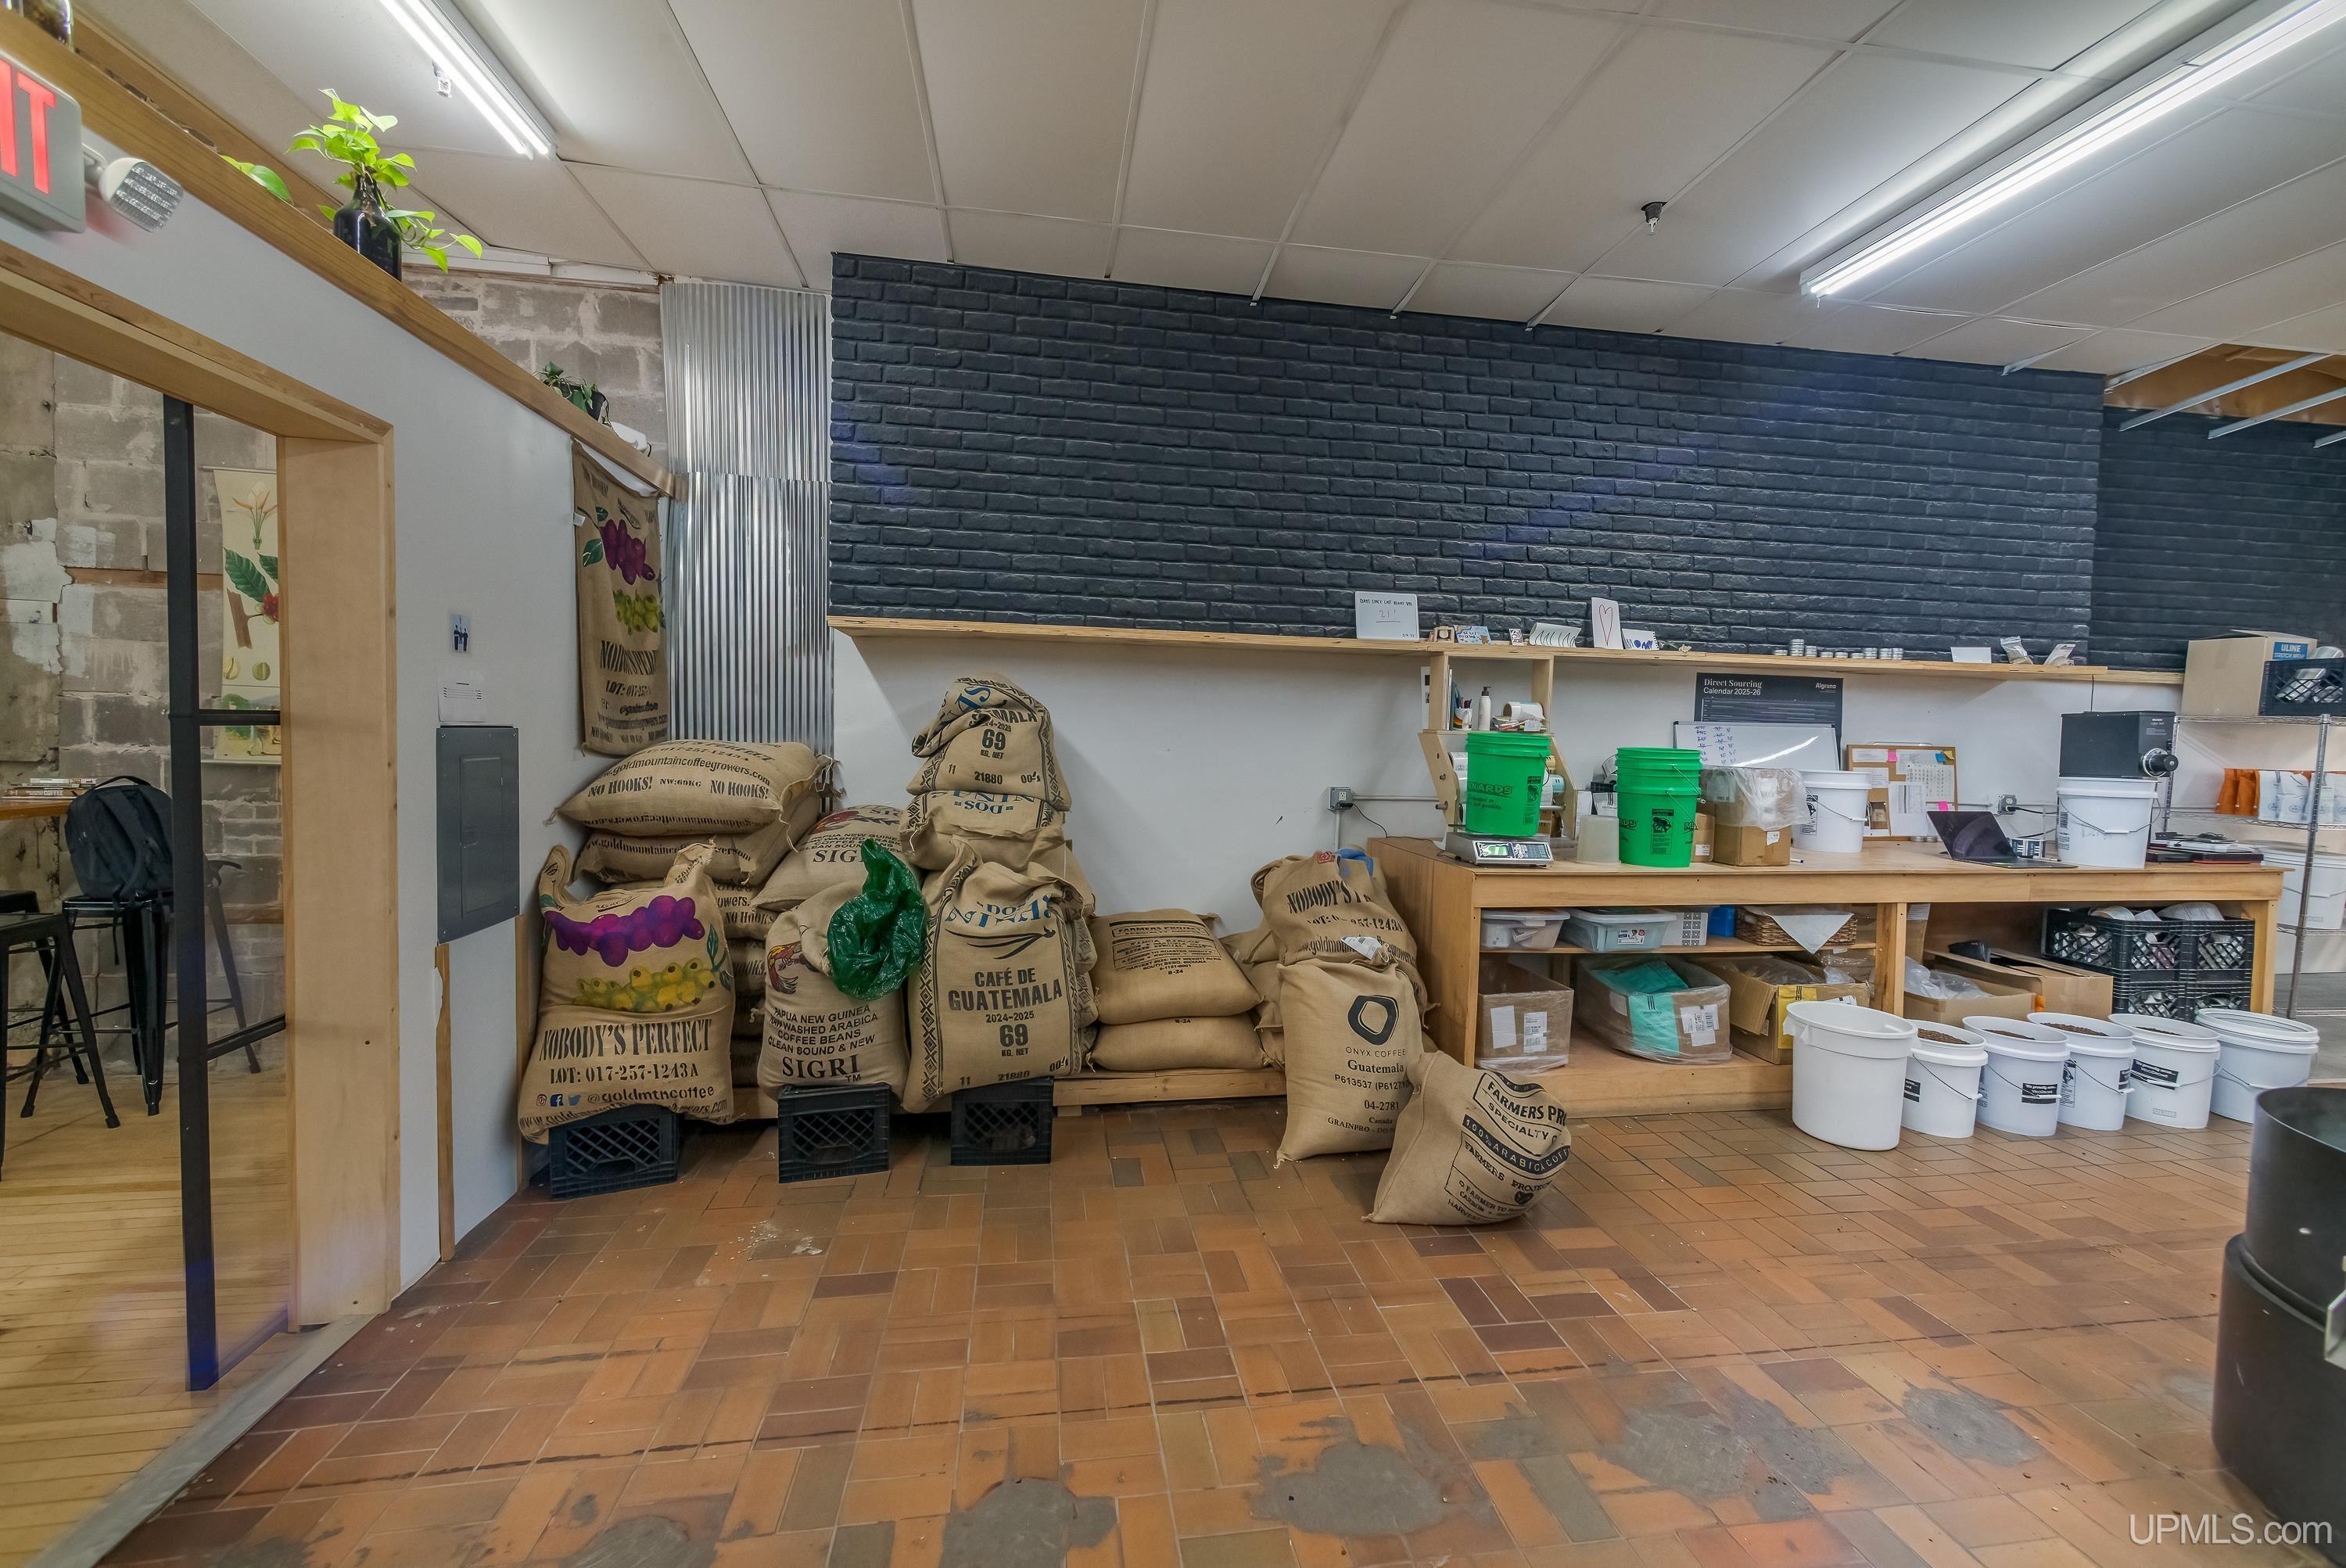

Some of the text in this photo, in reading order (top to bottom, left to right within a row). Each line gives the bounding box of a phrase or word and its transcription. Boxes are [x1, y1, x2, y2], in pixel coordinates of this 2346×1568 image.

[0, 58, 56, 194] IT
[2280, 644, 2301, 652] ULINE
[1704, 678, 1763, 689] Direct Sourcing
[1815, 682, 1837, 691] Algrano
[981, 728, 1006, 751] 69
[992, 751, 1005, 759] NET
[974, 771, 1003, 784] 21880
[588, 784, 606, 798] NO
[608, 776, 654, 795] HOOKS!
[710, 779, 726, 795] NO
[727, 781, 769, 800] HOOKS!
[812, 849, 862, 863] SIG
[725, 911, 738, 924] NO
[974, 967, 1036, 988] CAFÉ DE
[774, 1004, 870, 1024] PAPUA NEW GUINEA
[985, 1010, 1035, 1024] 2024-2025
[782, 1022, 826, 1035] WASHED
[829, 1013, 878, 1033] ARABICA
[539, 1018, 712, 1062] NOBODY'S PERFECT
[778, 1028, 861, 1045] COFFEE BEANS
[999, 1023, 1029, 1047] 69
[768, 1034, 876, 1056] CLEAN SOUND & NEW
[1016, 1047, 1029, 1056] NET
[1345, 1046, 1407, 1058] ONYX COFFEE
[550, 1062, 699, 1085] LOT: 017-257-1243A
[782, 1053, 860, 1078] SIGRI
[1347, 1059, 1404, 1074] Guatemala
[845, 1075, 861, 1083] TM
[960, 1076, 970, 1086] 11
[1334, 1074, 1372, 1089] P613537
[1487, 1081, 1544, 1120] FARMERS
[1327, 1117, 1370, 1132] GRAINPRO
[1487, 1102, 1550, 1140] SPECIALTY
[1465, 1141, 1505, 1182] FARMERS
[1466, 1186, 1496, 1210] FARMER
